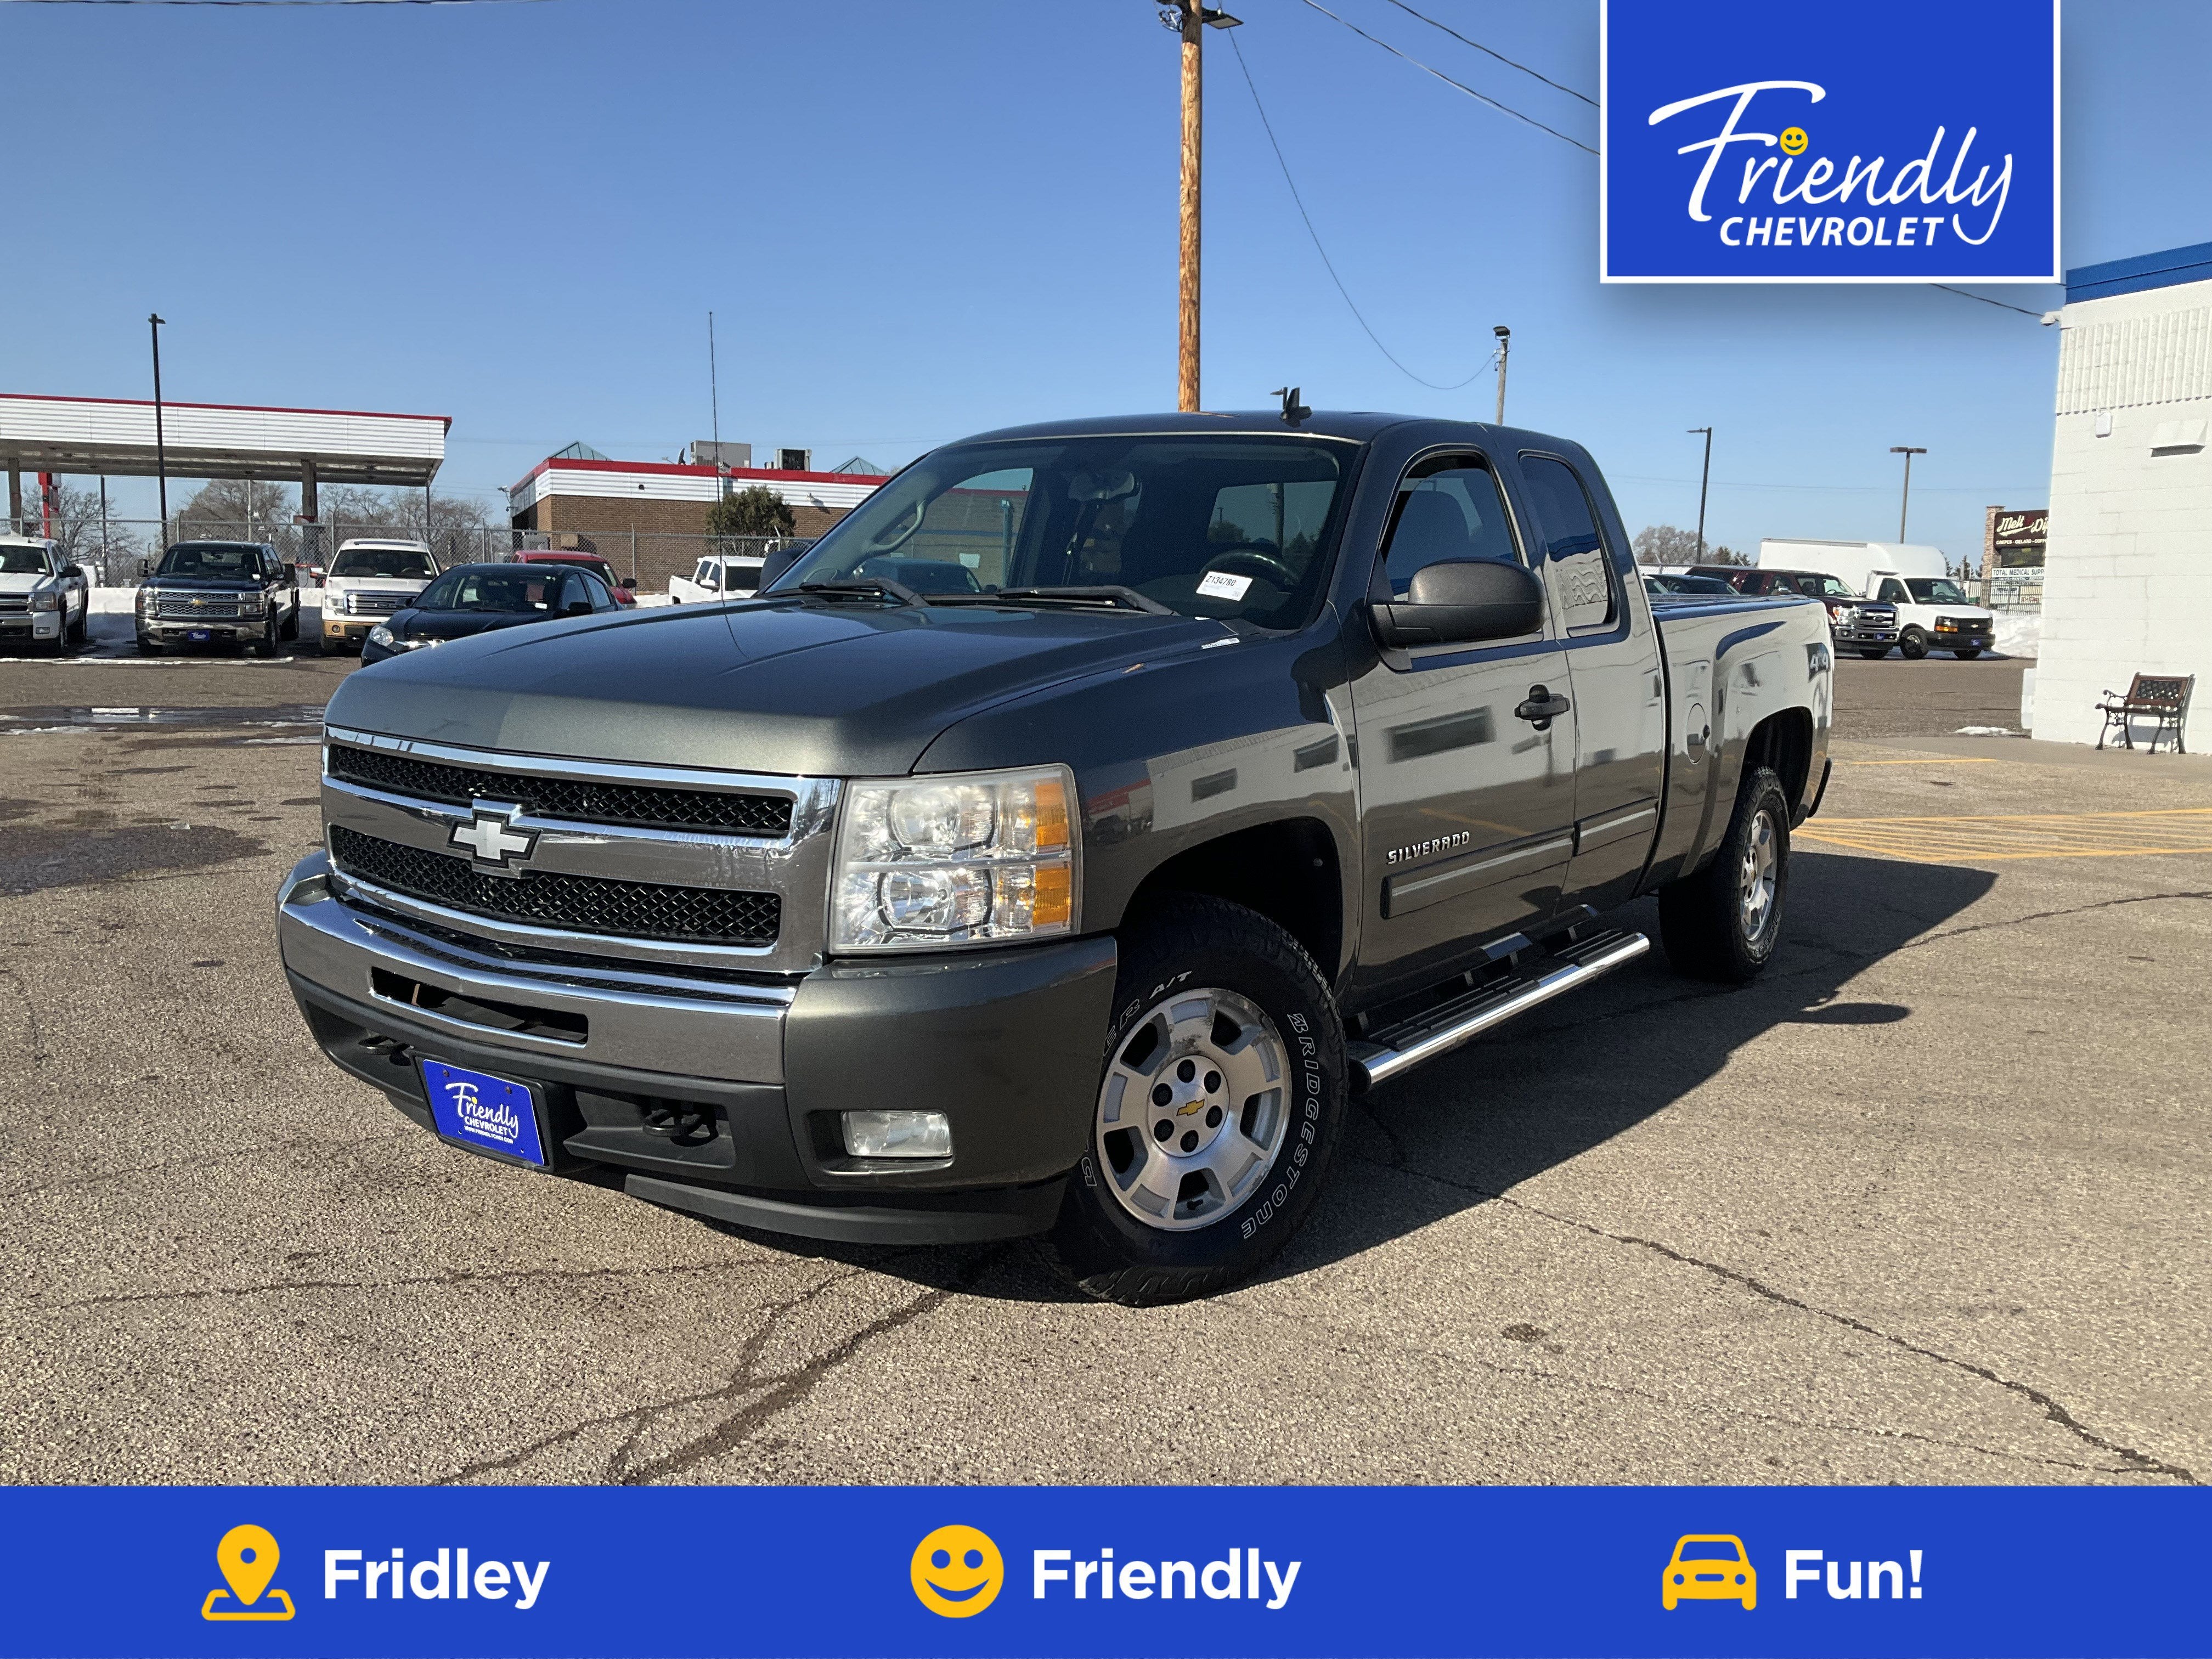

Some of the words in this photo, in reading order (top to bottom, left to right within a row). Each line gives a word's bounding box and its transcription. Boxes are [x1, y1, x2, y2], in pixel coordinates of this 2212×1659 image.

[1997, 515, 2024, 532] Melt
[1387, 831, 1470, 865] SILVERADO
[1149, 970, 1192, 1000] A/T
[446, 1082, 518, 1138] Friendly
[464, 1116, 508, 1136] CHEVROLET
[1241, 1013, 1319, 1239] BRIDGESTONE
